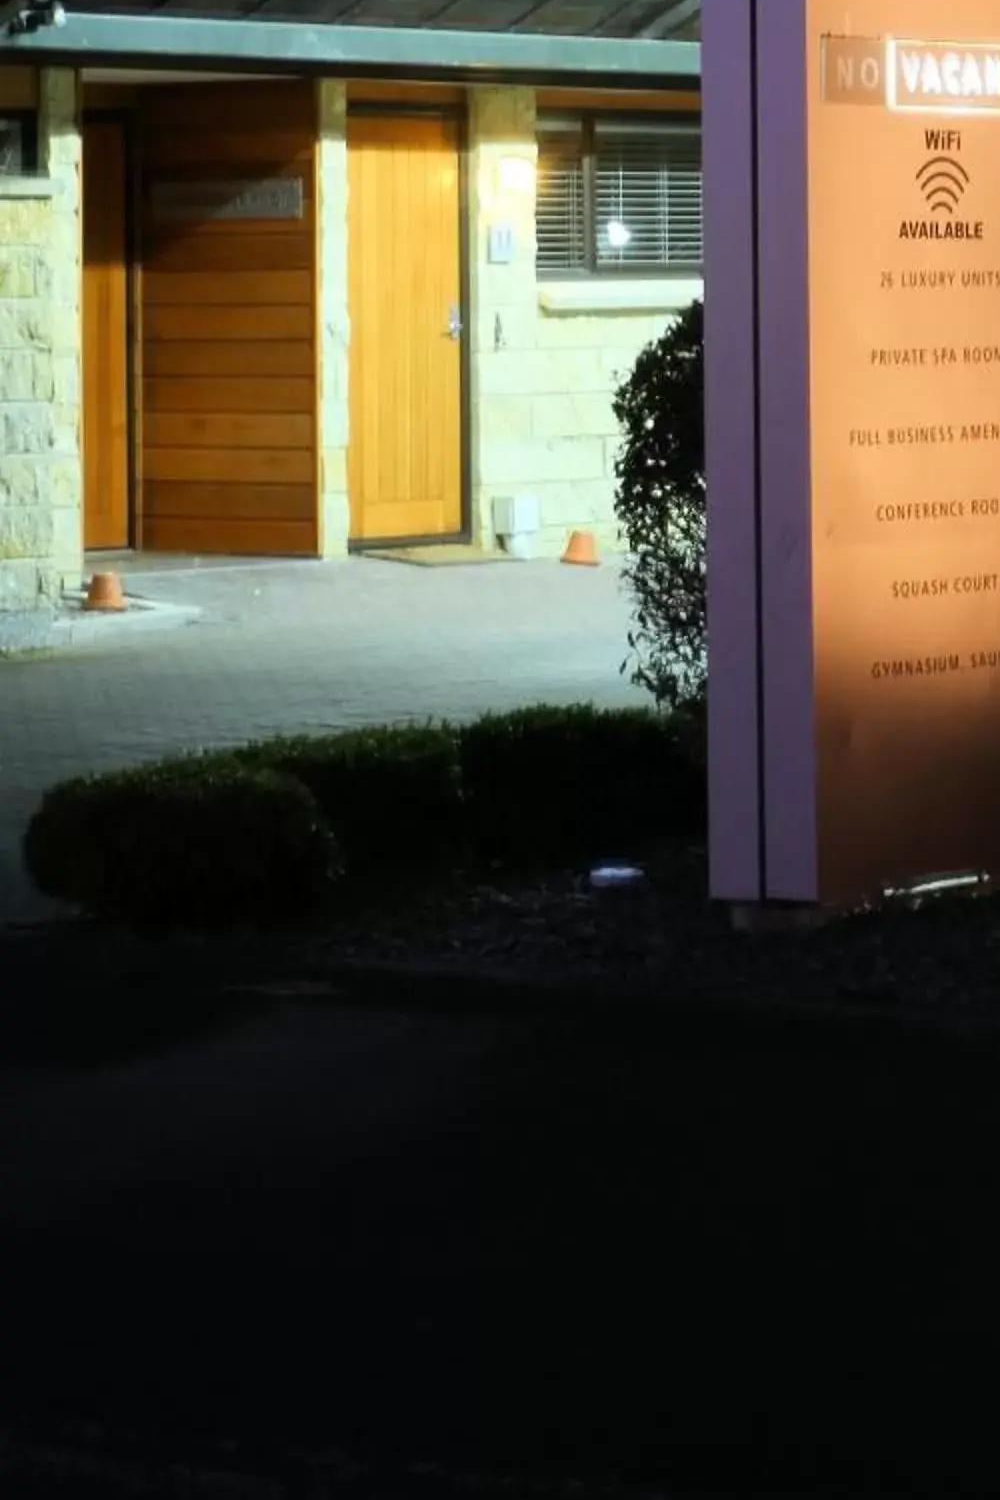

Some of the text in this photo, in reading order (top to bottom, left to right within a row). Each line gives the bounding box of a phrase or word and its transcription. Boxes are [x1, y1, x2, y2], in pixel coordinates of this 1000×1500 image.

[837, 56, 879, 90] NO
[925, 130, 961, 151] WiFi
[899, 221, 983, 240] AVAILABLE
[901, 270, 956, 288] LUXURY
[871, 348, 927, 365] PRIVATE
[933, 347, 957, 366] SPA
[850, 429, 881, 446] FULL
[887, 425, 954, 444] BUSINESS
[876, 501, 964, 521] CONFERENCE
[892, 574, 998, 598] SQUASH COURT
